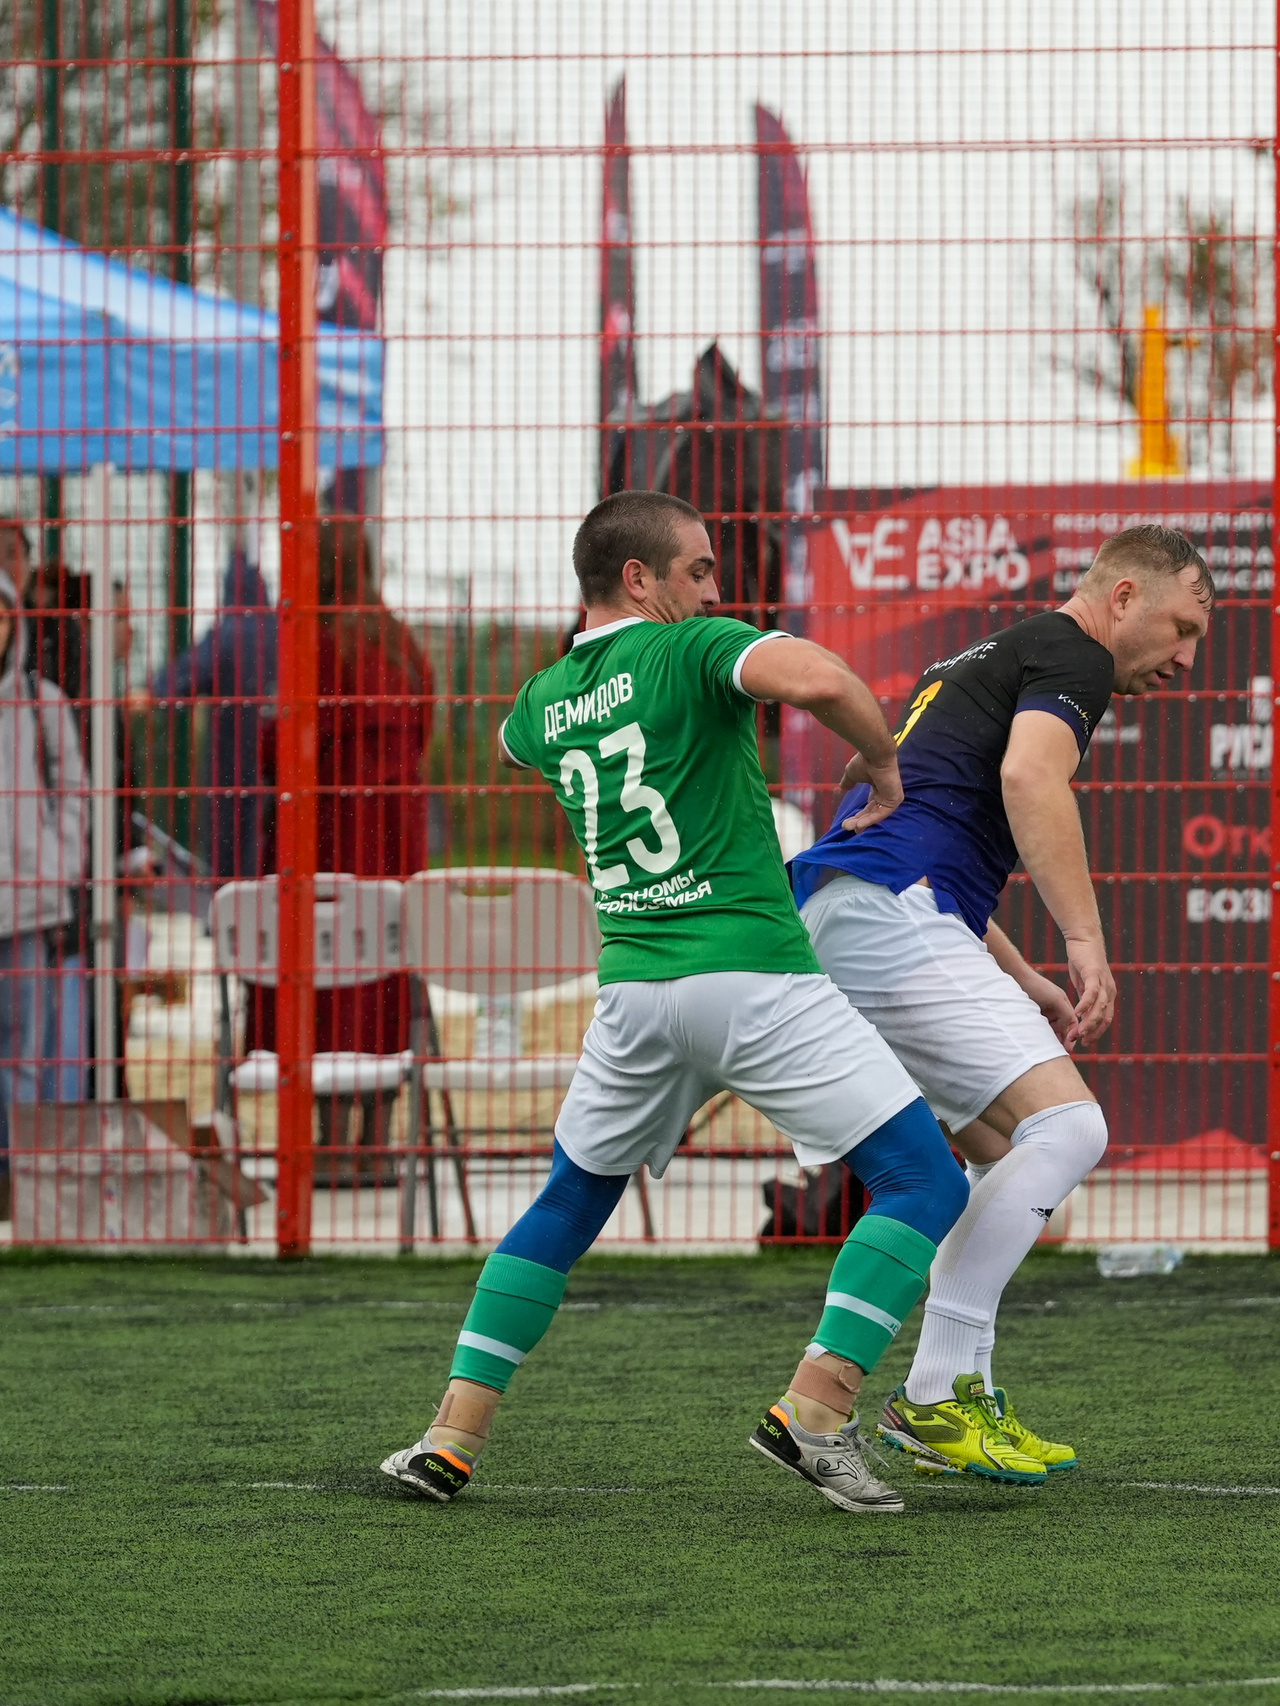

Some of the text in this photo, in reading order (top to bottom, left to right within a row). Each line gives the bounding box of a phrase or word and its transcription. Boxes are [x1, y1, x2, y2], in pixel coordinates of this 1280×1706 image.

[917, 517, 1018, 551] ASIA
[916, 552, 1031, 590] EXPO
[544, 672, 634, 744] ДЕМИДОВ
[559, 721, 682, 892] 23
